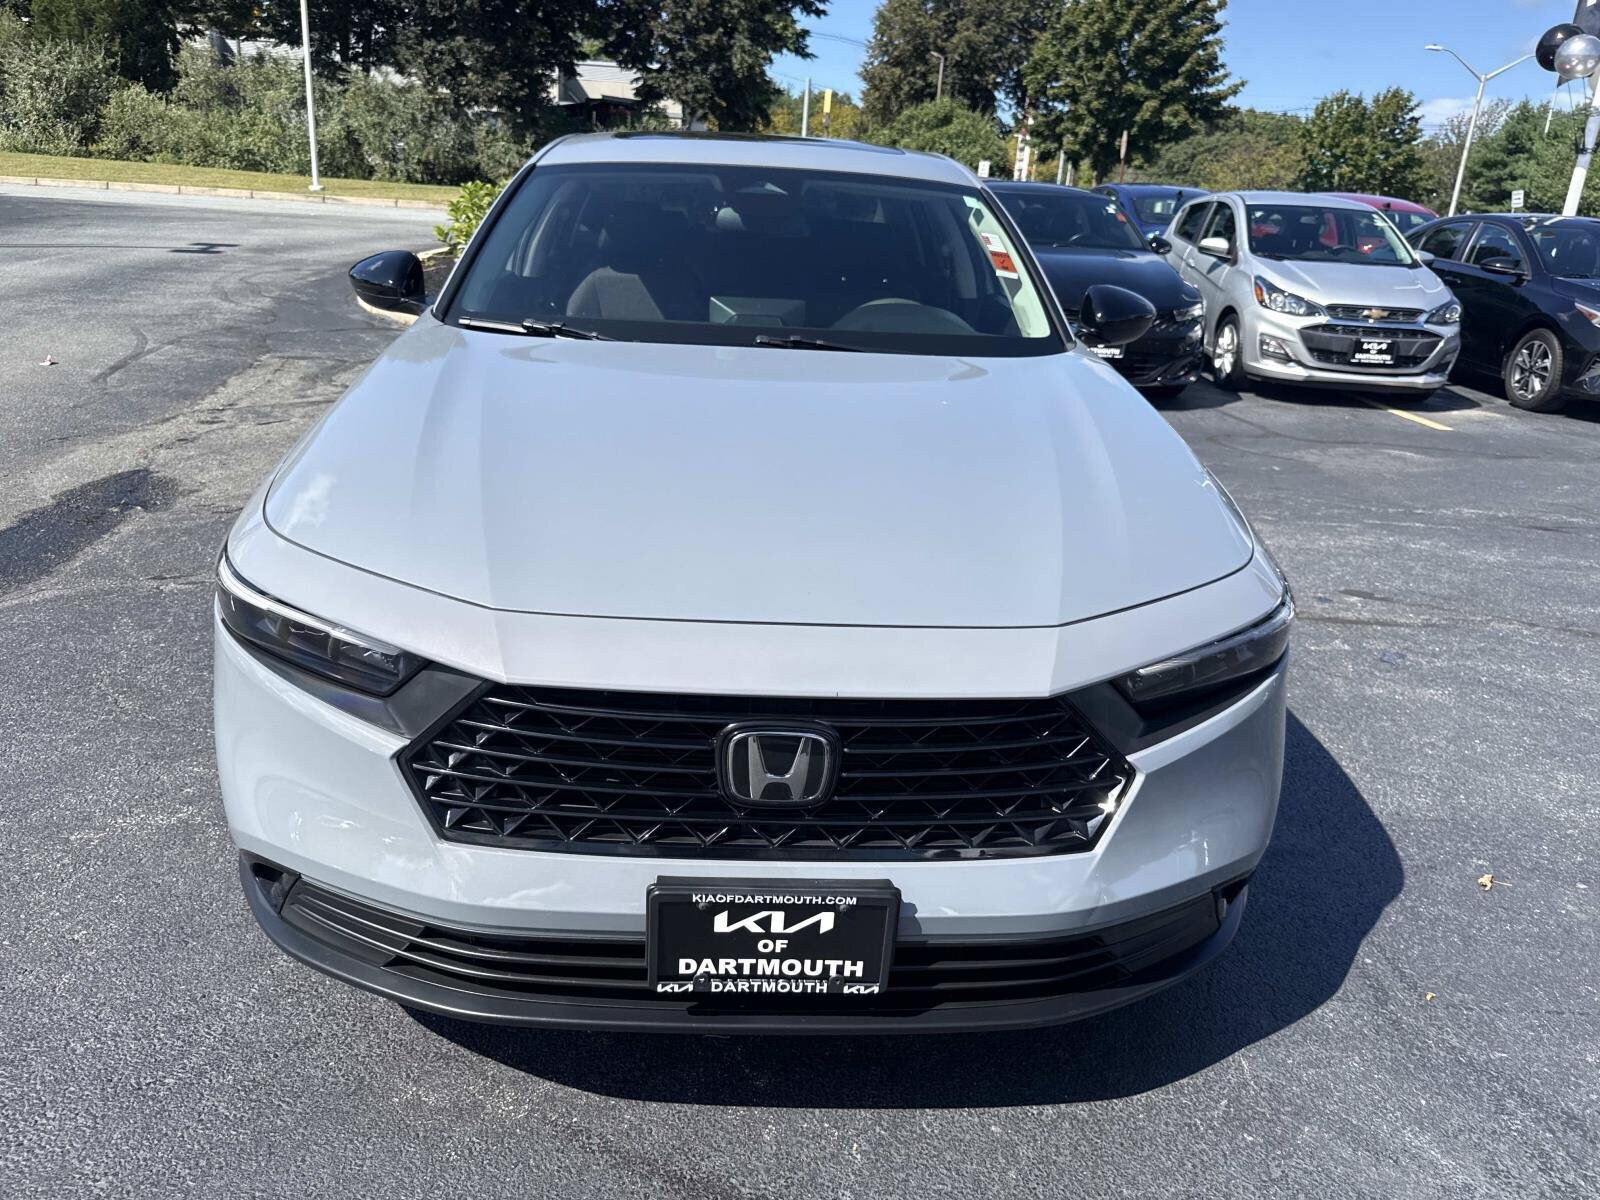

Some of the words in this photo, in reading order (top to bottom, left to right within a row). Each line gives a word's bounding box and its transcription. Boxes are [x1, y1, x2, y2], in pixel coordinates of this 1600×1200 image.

[692, 893, 857, 905] KIAOFDARTMOUTH.COM
[714, 910, 835, 934] KIA
[757, 939, 788, 953] OF
[678, 958, 864, 977] DARTMOUTH
[711, 981, 828, 993] DARTMOUTH
